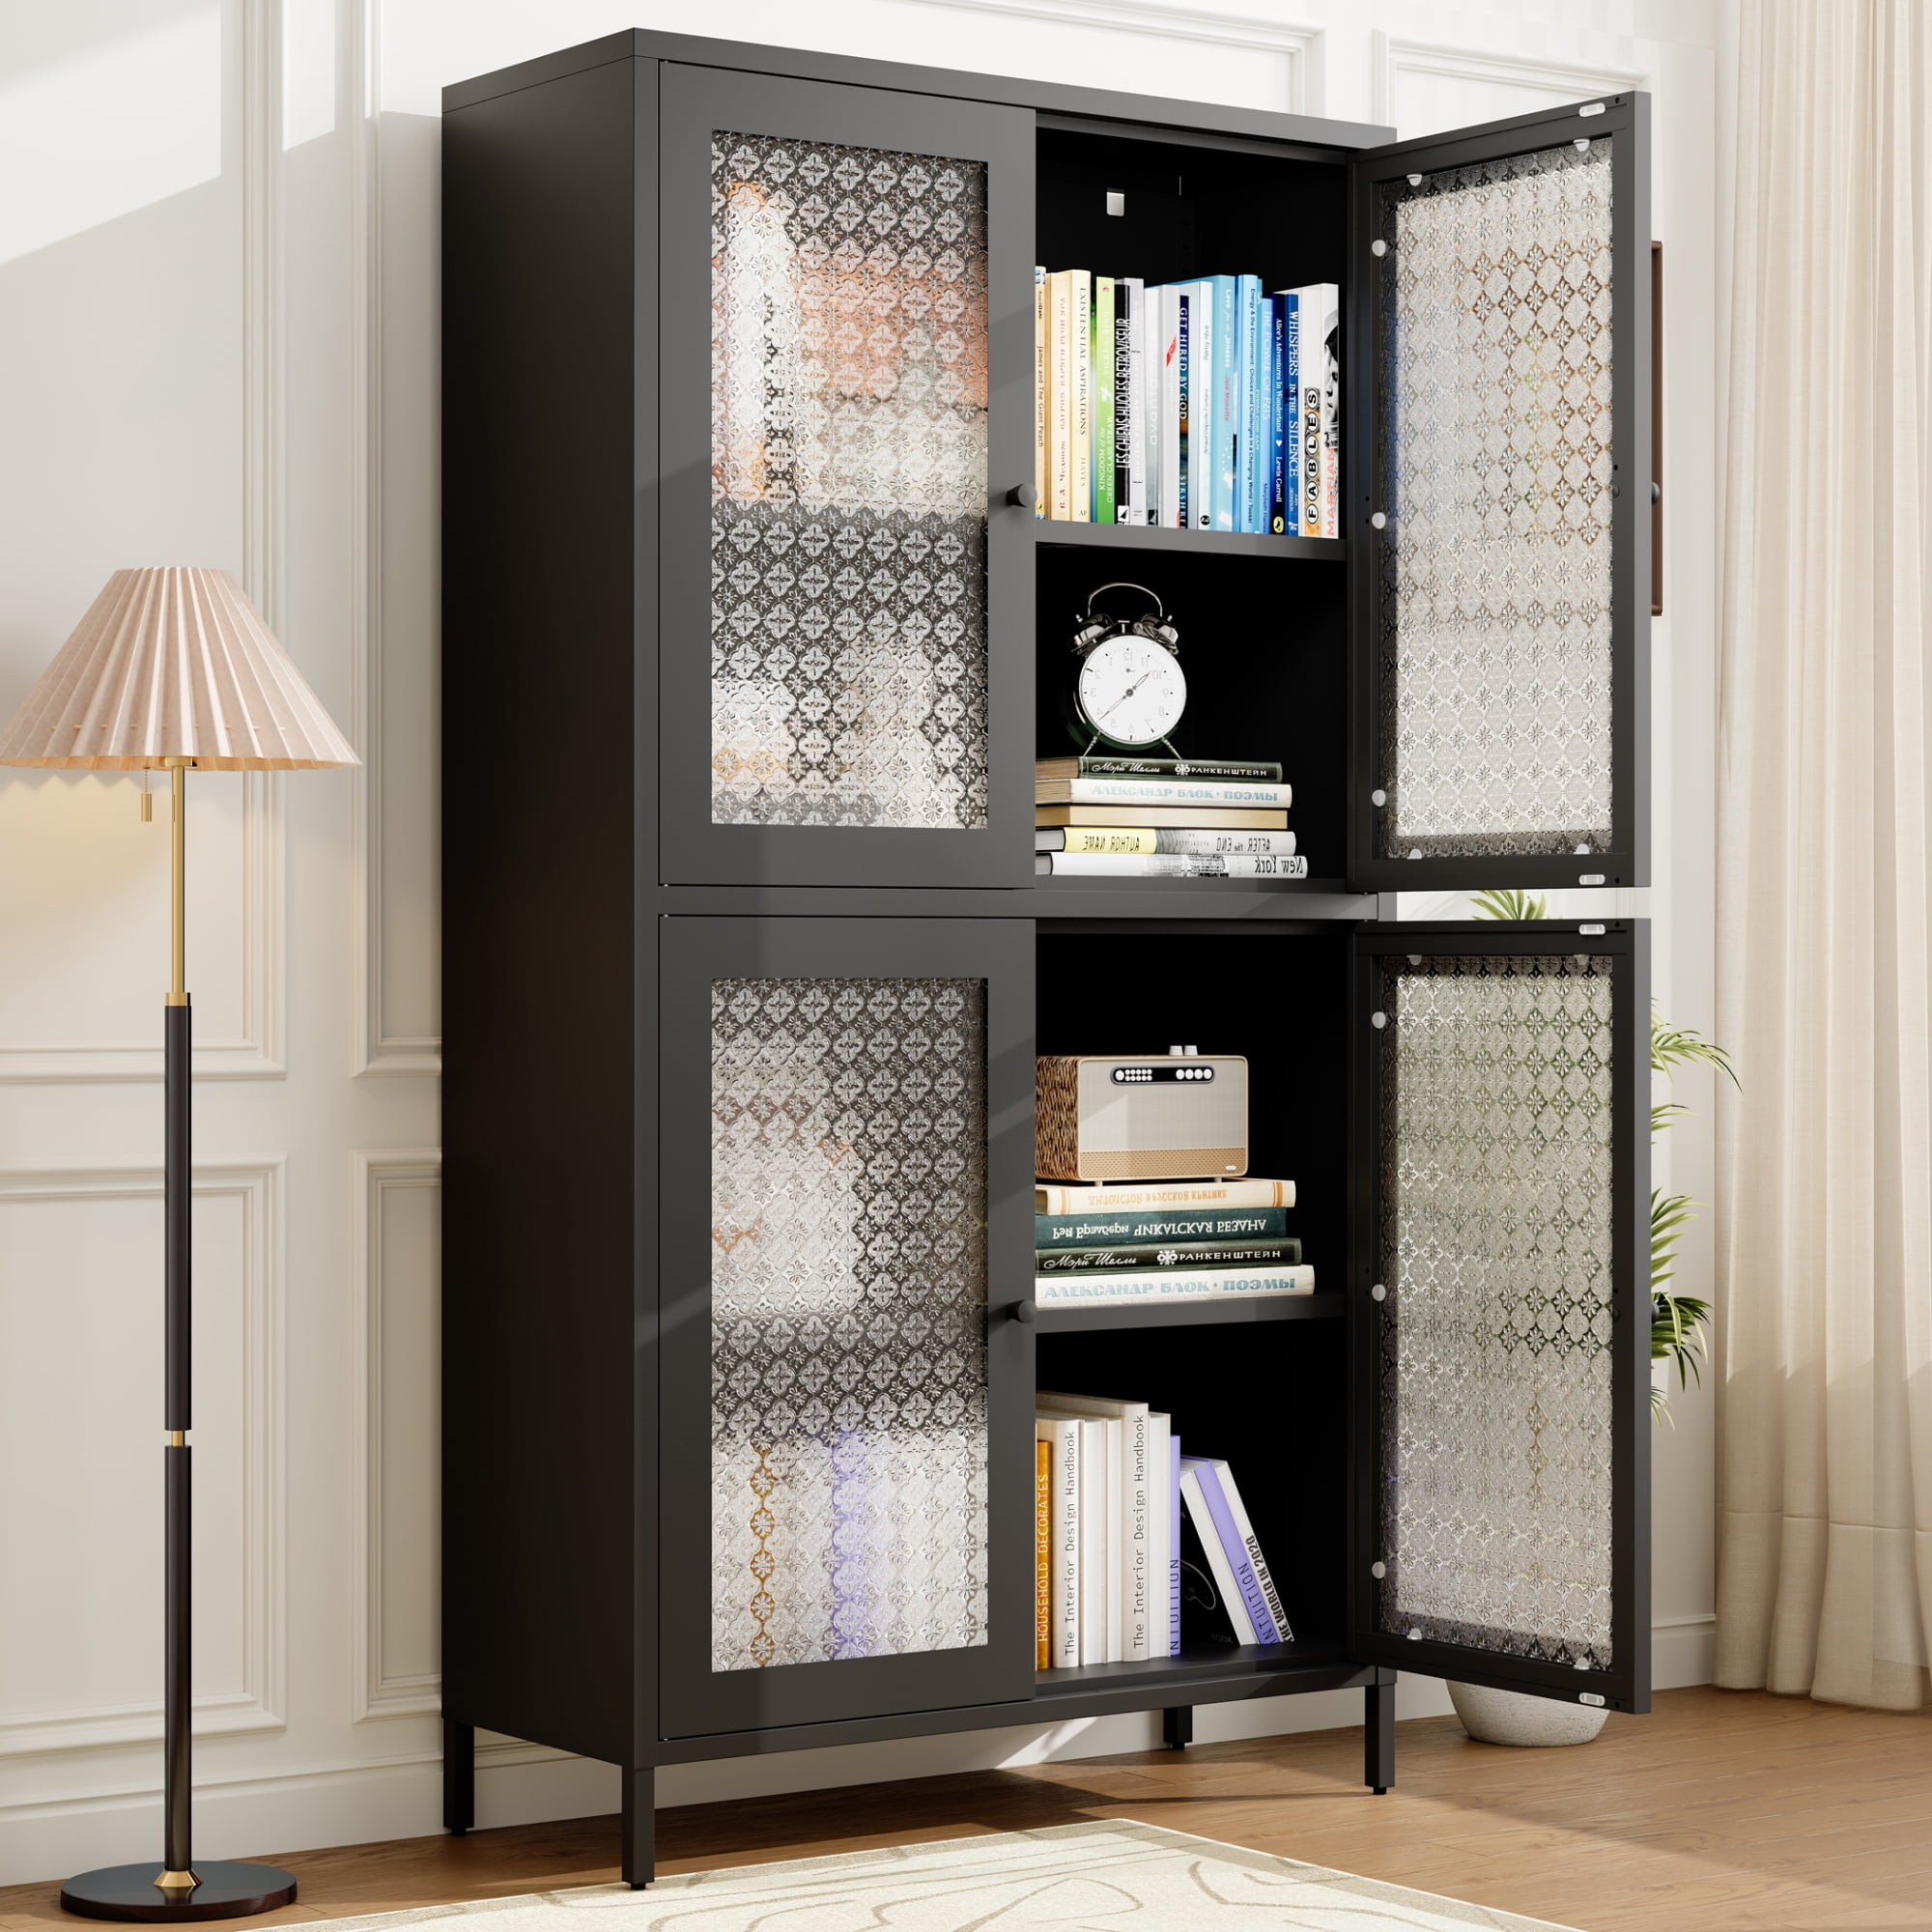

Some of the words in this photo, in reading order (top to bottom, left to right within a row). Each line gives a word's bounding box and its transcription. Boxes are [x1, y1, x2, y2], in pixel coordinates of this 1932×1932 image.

[1116, 319, 1129, 378] RETROVISEUR
[1290, 311, 1298, 376] WHISPERS
[1179, 376, 1187, 389] BY
[1290, 384, 1296, 393] IN
[1116, 417, 1129, 451] CHIENS
[1289, 420, 1298, 477] SILENCE
[1307, 391, 1318, 522] FABLES
[1116, 453, 1129, 469] LES
[1326, 448, 1335, 537] MARTIAN
[1093, 785, 1173, 798] АЛЕКСАНДР
[1177, 788, 1214, 800] БЛОК
[1223, 790, 1279, 803] ПОЭМЫ
[1044, 1283, 1154, 1298] АЛЕКСАНДР
[1160, 1282, 1210, 1293] БЛОК
[1223, 1278, 1296, 1292] ПОЭМЫ
[1065, 1432, 1075, 1496] Handbook
[1133, 1415, 1145, 1483] Handbook
[1037, 1473, 1049, 1553] DECORATES
[1065, 1503, 1077, 1551] Design
[1133, 1490, 1146, 1540] Design
[1245, 1534, 1264, 1567] 2020
[1257, 1566, 1269, 1581] IN
[1037, 1562, 1049, 1643] HOUSEHOLD
[1065, 1560, 1075, 1624] Interior
[1133, 1549, 1145, 1615] Interior
[1262, 1580, 1285, 1624] WORLD
[1065, 1633, 1075, 1657] The
[1133, 1623, 1145, 1649] The
